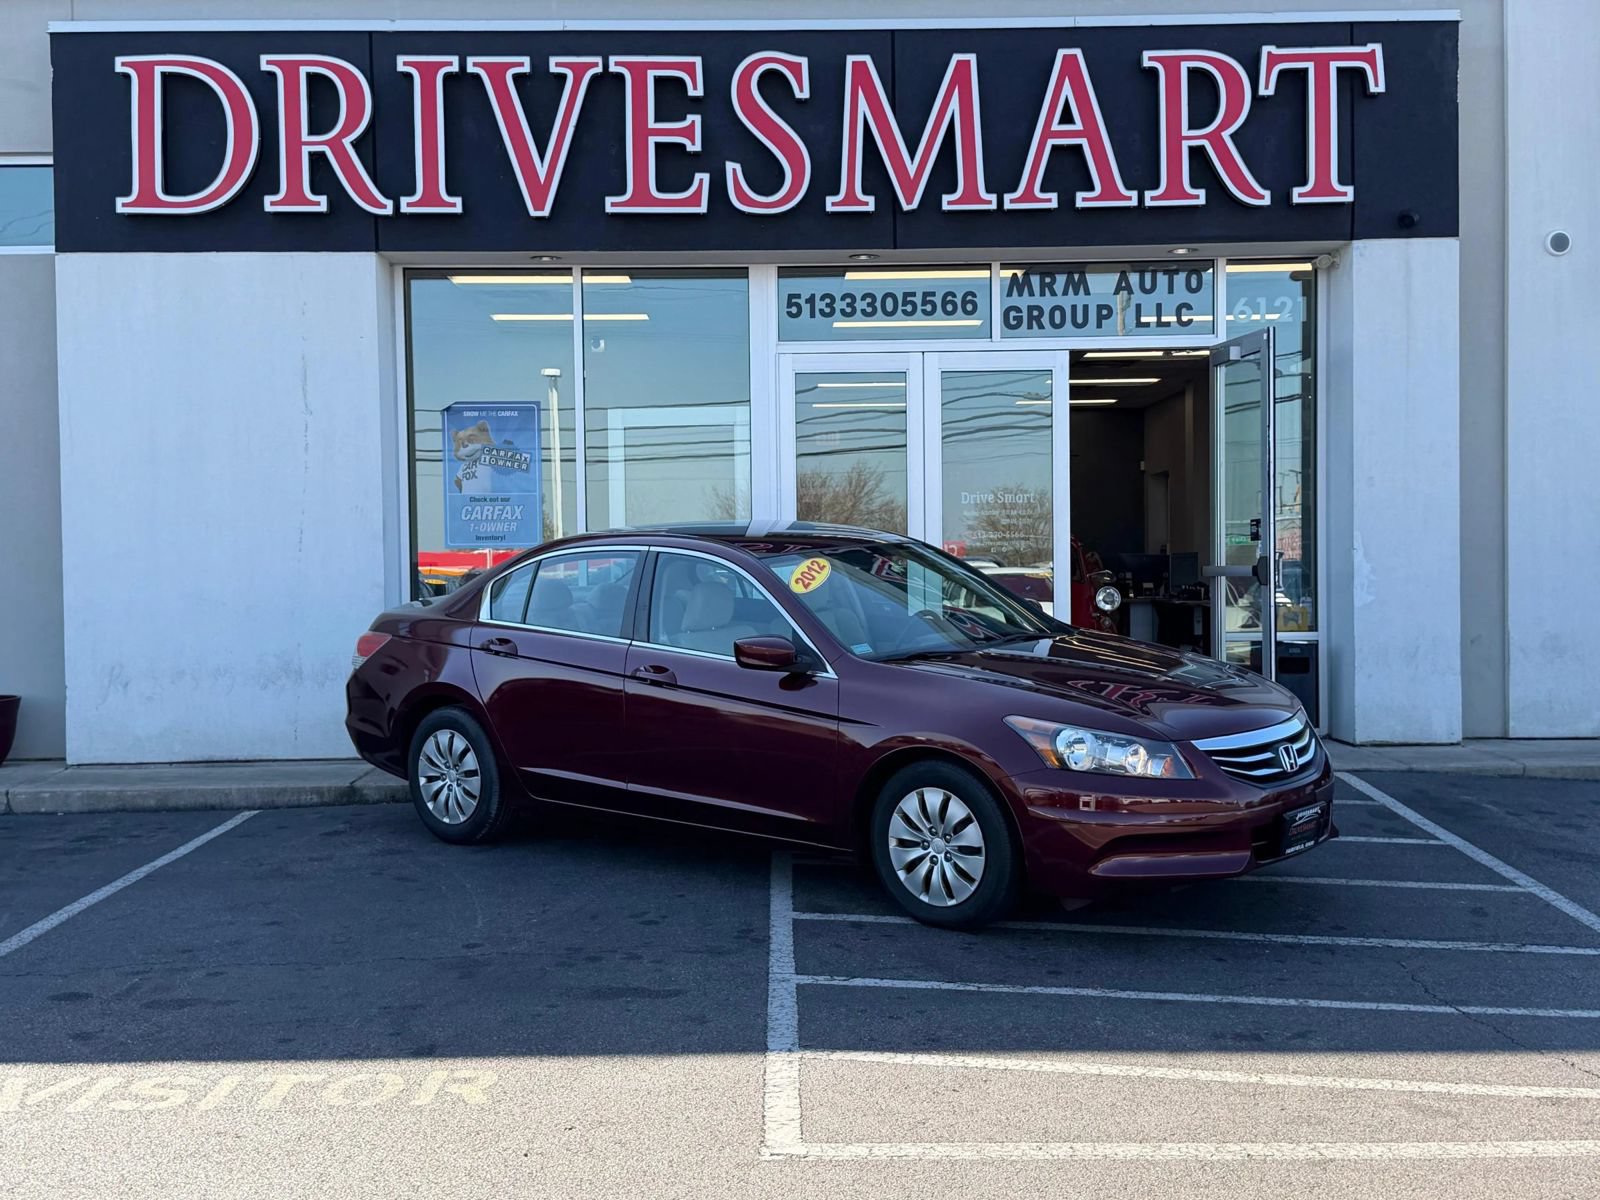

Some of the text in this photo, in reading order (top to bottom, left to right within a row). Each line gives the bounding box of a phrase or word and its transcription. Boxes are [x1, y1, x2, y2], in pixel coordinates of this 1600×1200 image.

[113, 45, 1387, 217] DRIVESMART
[1006, 269, 1203, 297] MRM AUTO
[785, 291, 978, 319] 5133305566
[1003, 302, 1194, 330] GROUP LLC
[1233, 296, 1307, 323] 6121
[483, 446, 530, 462] CARFAX
[490, 459, 529, 471] OWNER
[961, 491, 1035, 504] Drive Smart
[461, 505, 524, 521] CARFAX
[470, 522, 518, 532] 1-OWNER
[794, 560, 827, 591] 2012
[0, 1070, 497, 1112] VISITOR
